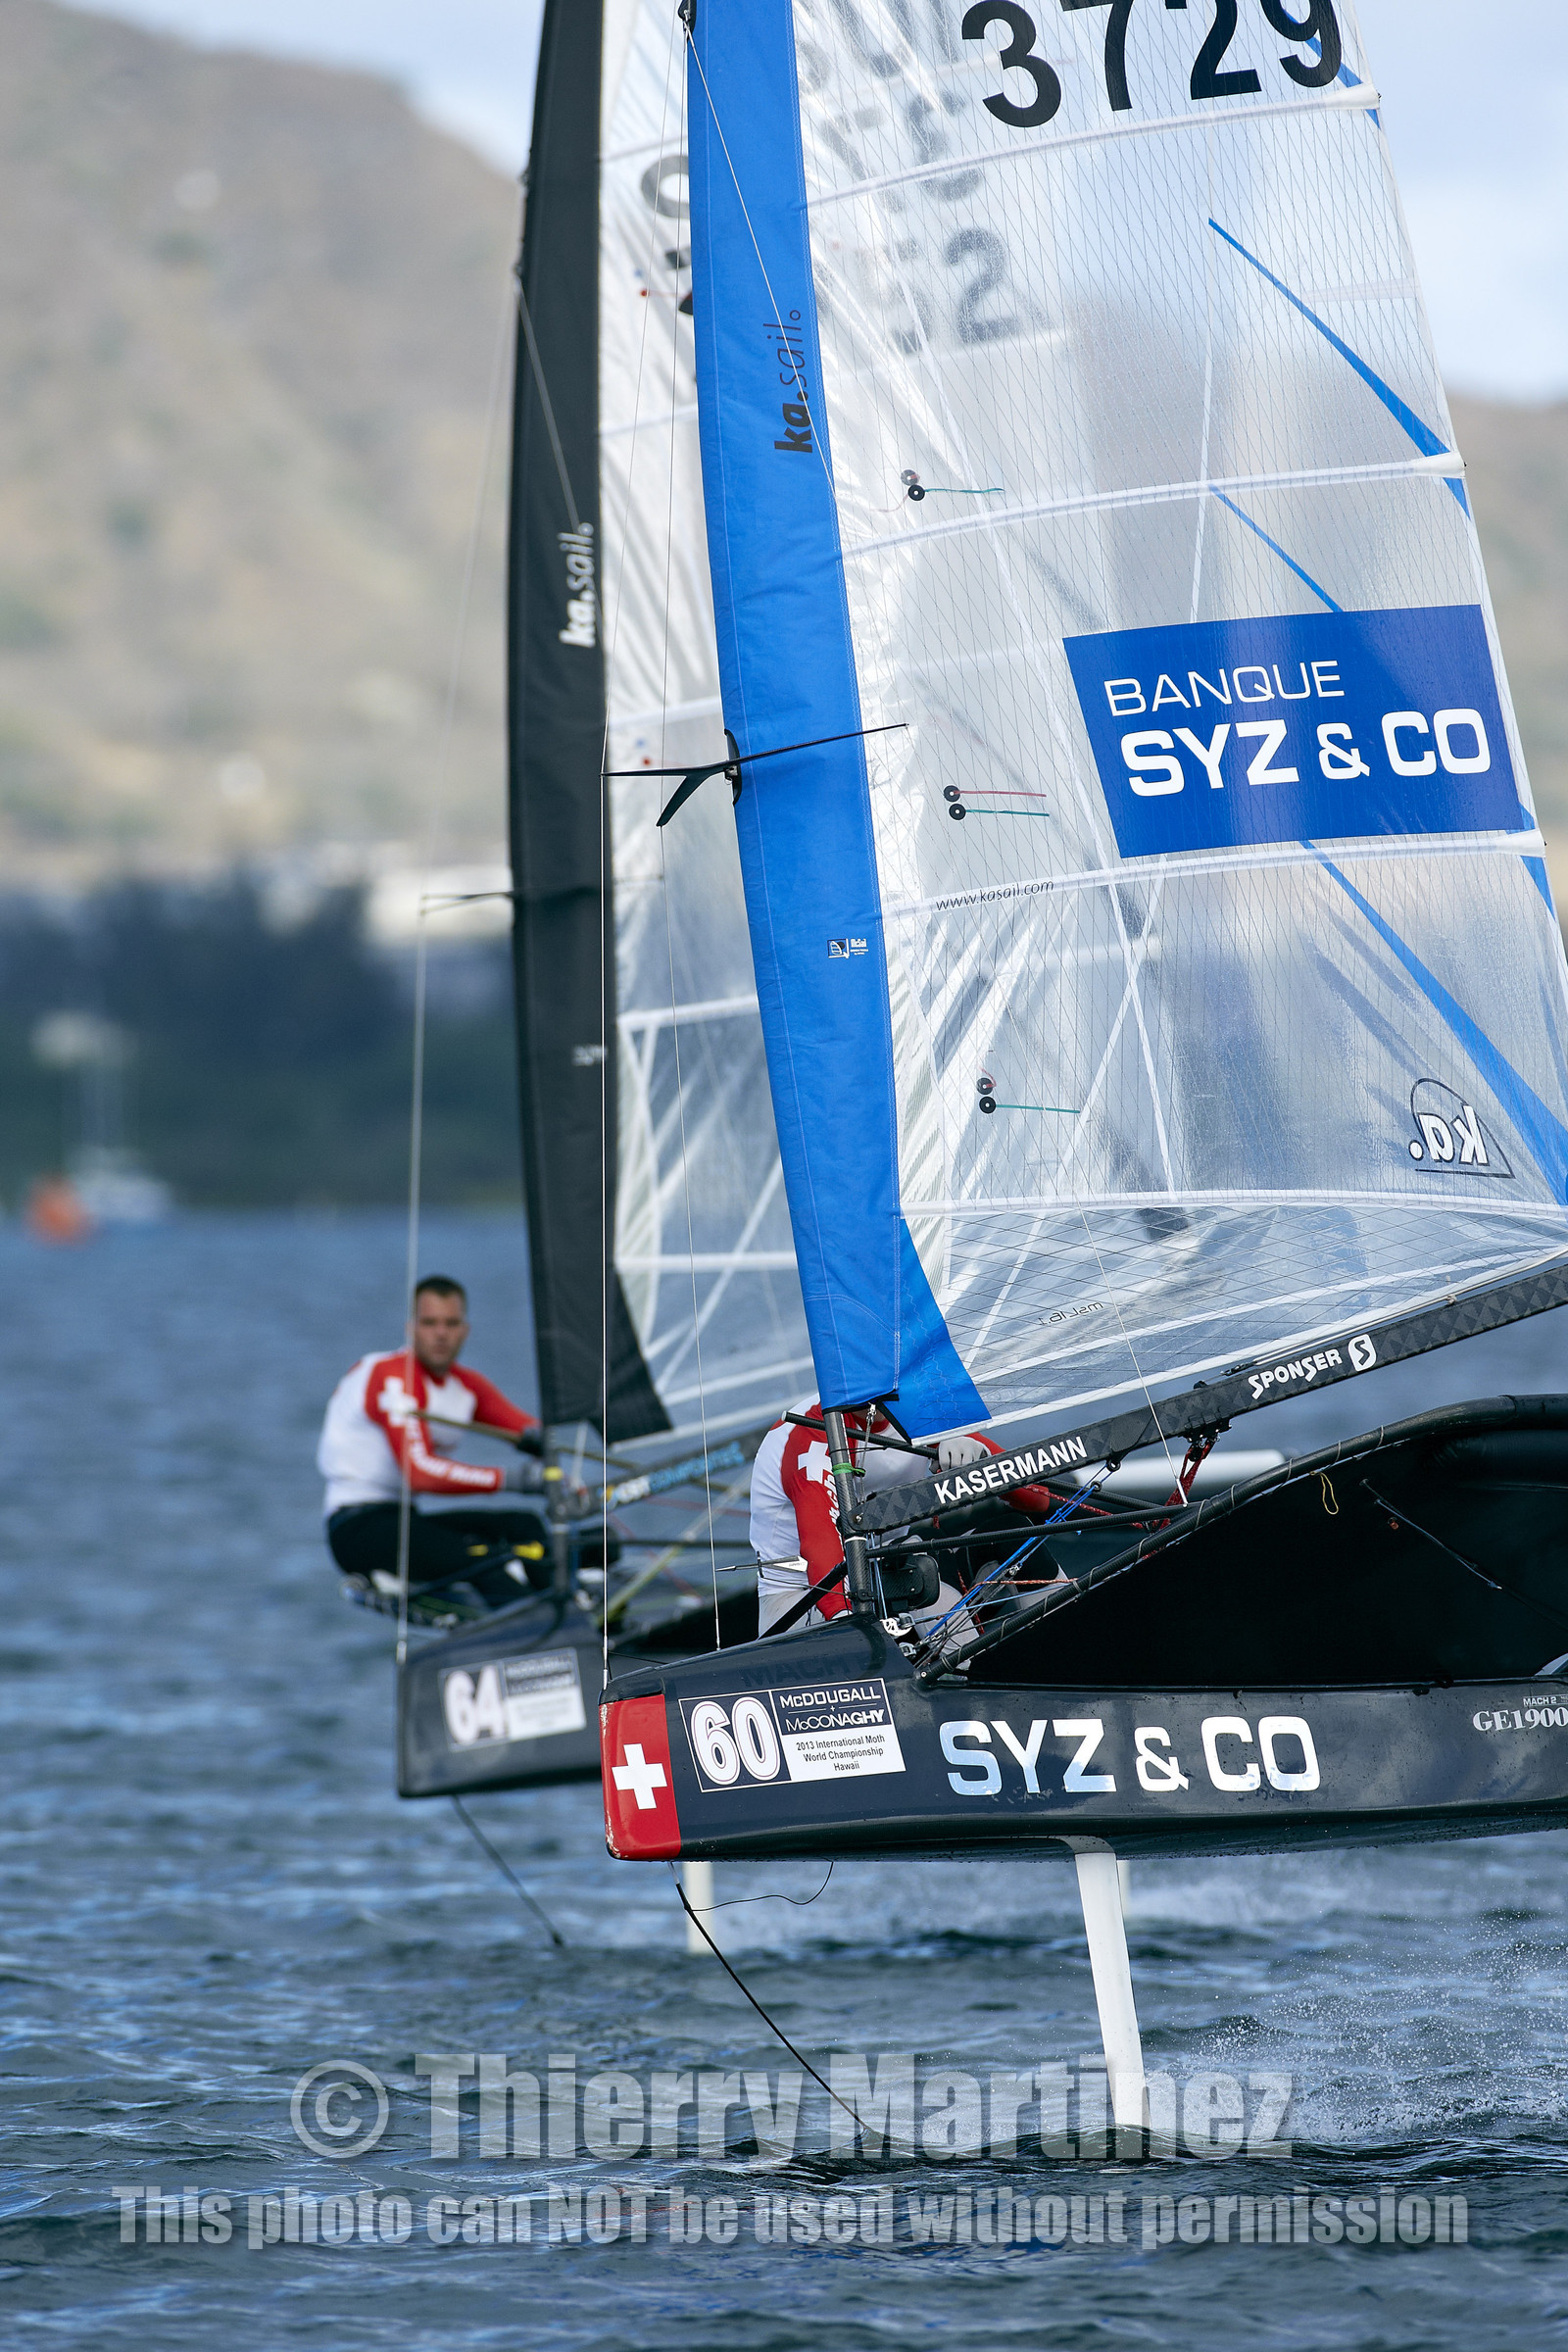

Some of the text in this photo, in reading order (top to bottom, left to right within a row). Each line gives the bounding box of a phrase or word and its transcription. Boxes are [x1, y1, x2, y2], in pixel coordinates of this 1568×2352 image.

[961, 0, 1343, 128] 3729
[1103, 660, 1346, 717] BANQUE
[1120, 708, 1492, 797] SYZ & CO
[936, 880, 1054, 911] www.kasail.com
[1248, 1348, 1343, 1399] SPONSER
[934, 1436, 1088, 1504] KASERMANN
[444, 1664, 506, 1746] 64
[779, 1686, 882, 1709] McDOUGALL
[1523, 1696, 1549, 1706] MACH
[1550, 1695, 1557, 1704] 2
[785, 1709, 885, 1732] McCONAGHY
[1472, 1706, 1568, 1732] GE1900
[690, 1696, 782, 1786] 60
[796, 1734, 886, 1751] 2013 International Moth
[803, 1746, 884, 1762] World Championship
[939, 1715, 1321, 1796] SYZ & CO
[833, 1760, 860, 1772] Hawaii
